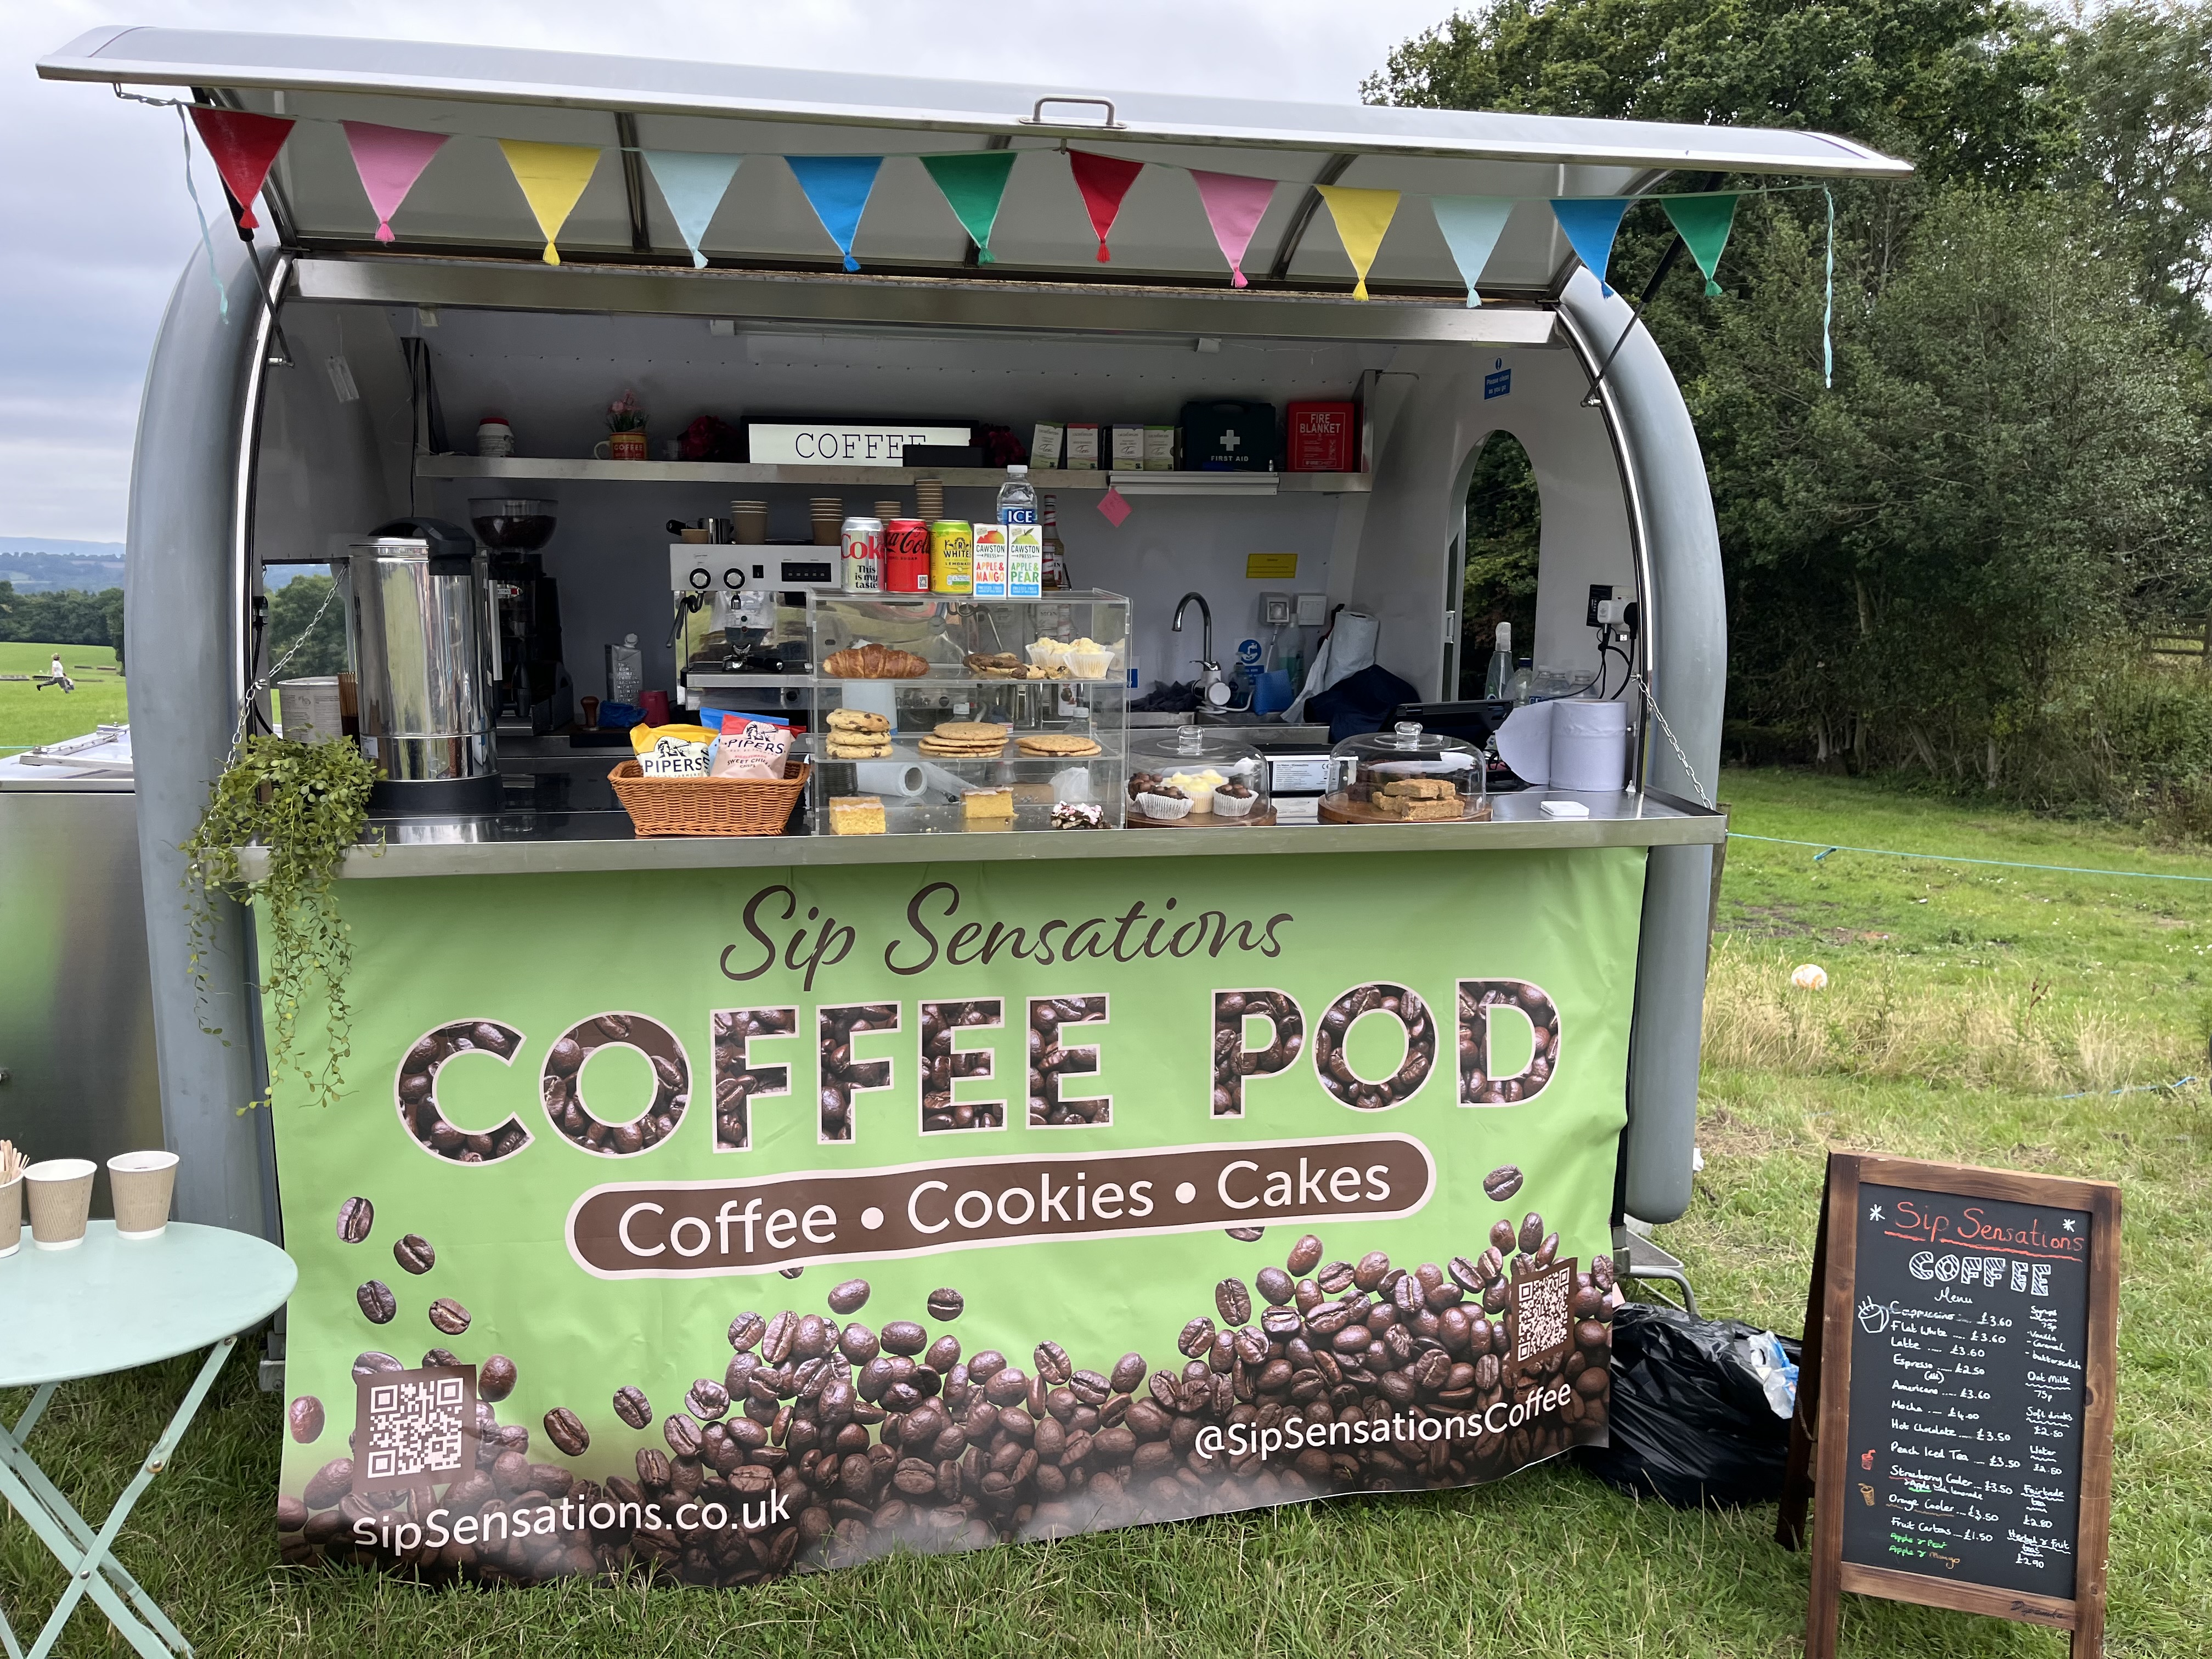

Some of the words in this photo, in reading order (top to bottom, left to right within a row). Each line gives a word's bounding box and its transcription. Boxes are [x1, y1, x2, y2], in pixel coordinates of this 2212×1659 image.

[1311, 414, 1330, 424] FIRE
[1300, 423, 1341, 433] BLANKET
[1008, 511, 1032, 523] ICE
[977, 545, 1005, 553] CAWSTON
[1011, 545, 1040, 553] CAWSTON
[857, 565, 876, 573] This
[977, 562, 997, 571] APPLE
[998, 562, 1005, 571] &
[1011, 562, 1032, 571] APPLE
[1034, 562, 1039, 571] &
[864, 574, 878, 583] my
[976, 572, 1005, 582] MANGO
[1011, 572, 1039, 583] PEAR
[727, 739, 785, 754] PIPERS
[645, 758, 702, 773] PIPERS
[720, 884, 856, 992] Sip
[883, 881, 1294, 975] Sensations
[394, 992, 1114, 1167] COFFEE
[1210, 977, 1562, 1120] POD
[619, 1197, 838, 1258] Coffee
[906, 1171, 1155, 1235] Cookies
[1217, 1156, 1392, 1210] Cakes
[1895, 1201, 1950, 1242] Sip
[1957, 1207, 2085, 1251] Sensations
[1909, 1251, 2051, 1296] COFFEE
[1934, 1286, 1973, 1304] Menu
[1978, 1312, 2013, 1327] £3.60
[2041, 1322, 2057, 1332] 75p
[1891, 1320, 1917, 1334] Flat
[1920, 1325, 1948, 1338] White
[1970, 1330, 2007, 1344] £3.60
[1891, 1336, 1922, 1350] Latte
[1950, 1345, 1985, 1357] £3.60
[2032, 1339, 2066, 1352] Caramel
[1893, 1353, 1934, 1370] Espresso
[2032, 1350, 2082, 1370] butterscotch
[2027, 1371, 2046, 1383] Oat
[2048, 1375, 2072, 1385] Milk
[1892, 1379, 1939, 1395] Americano
[1960, 1388, 1991, 1400] £3.60
[2034, 1390, 2053, 1403] 75p
[1891, 1400, 1923, 1413] Mocha
[1948, 1407, 1980, 1421] £4.00
[2026, 1406, 2046, 1420] Soft
[2048, 1411, 2074, 1421] drinks
[1195, 1383, 1572, 1461] @SipSensationsCoffee
[1891, 1418, 1910, 1430] Hot
[1914, 1423, 1957, 1437] Chocolate
[1976, 1428, 2012, 1442] £3.50
[2034, 1425, 2064, 1438] £2.50
[1891, 1440, 1920, 1456] Peach
[1924, 1446, 1946, 1459] Iced
[1949, 1449, 1970, 1462] Tea
[1989, 1455, 2021, 1468] £3.50
[2029, 1445, 2056, 1456] Water
[1889, 1464, 1943, 1489] Strawberry
[1946, 1473, 1973, 1487] Cooler
[1984, 1480, 2014, 1495] £3.50
[1951, 1486, 1984, 1500] lemonade
[2023, 1483, 2066, 1498] Fairtrade
[1888, 1493, 1920, 1511] Orange
[1924, 1498, 1955, 1512] Cooler
[1968, 1505, 2000, 1521] £3.50
[1891, 1516, 1915, 1530] Fruit
[1963, 1528, 1994, 1542] £1.50
[1890, 1532, 1914, 1543] Apple
[2051, 1538, 2070, 1550] Fruit
[1888, 1545, 1915, 1557] Apple
